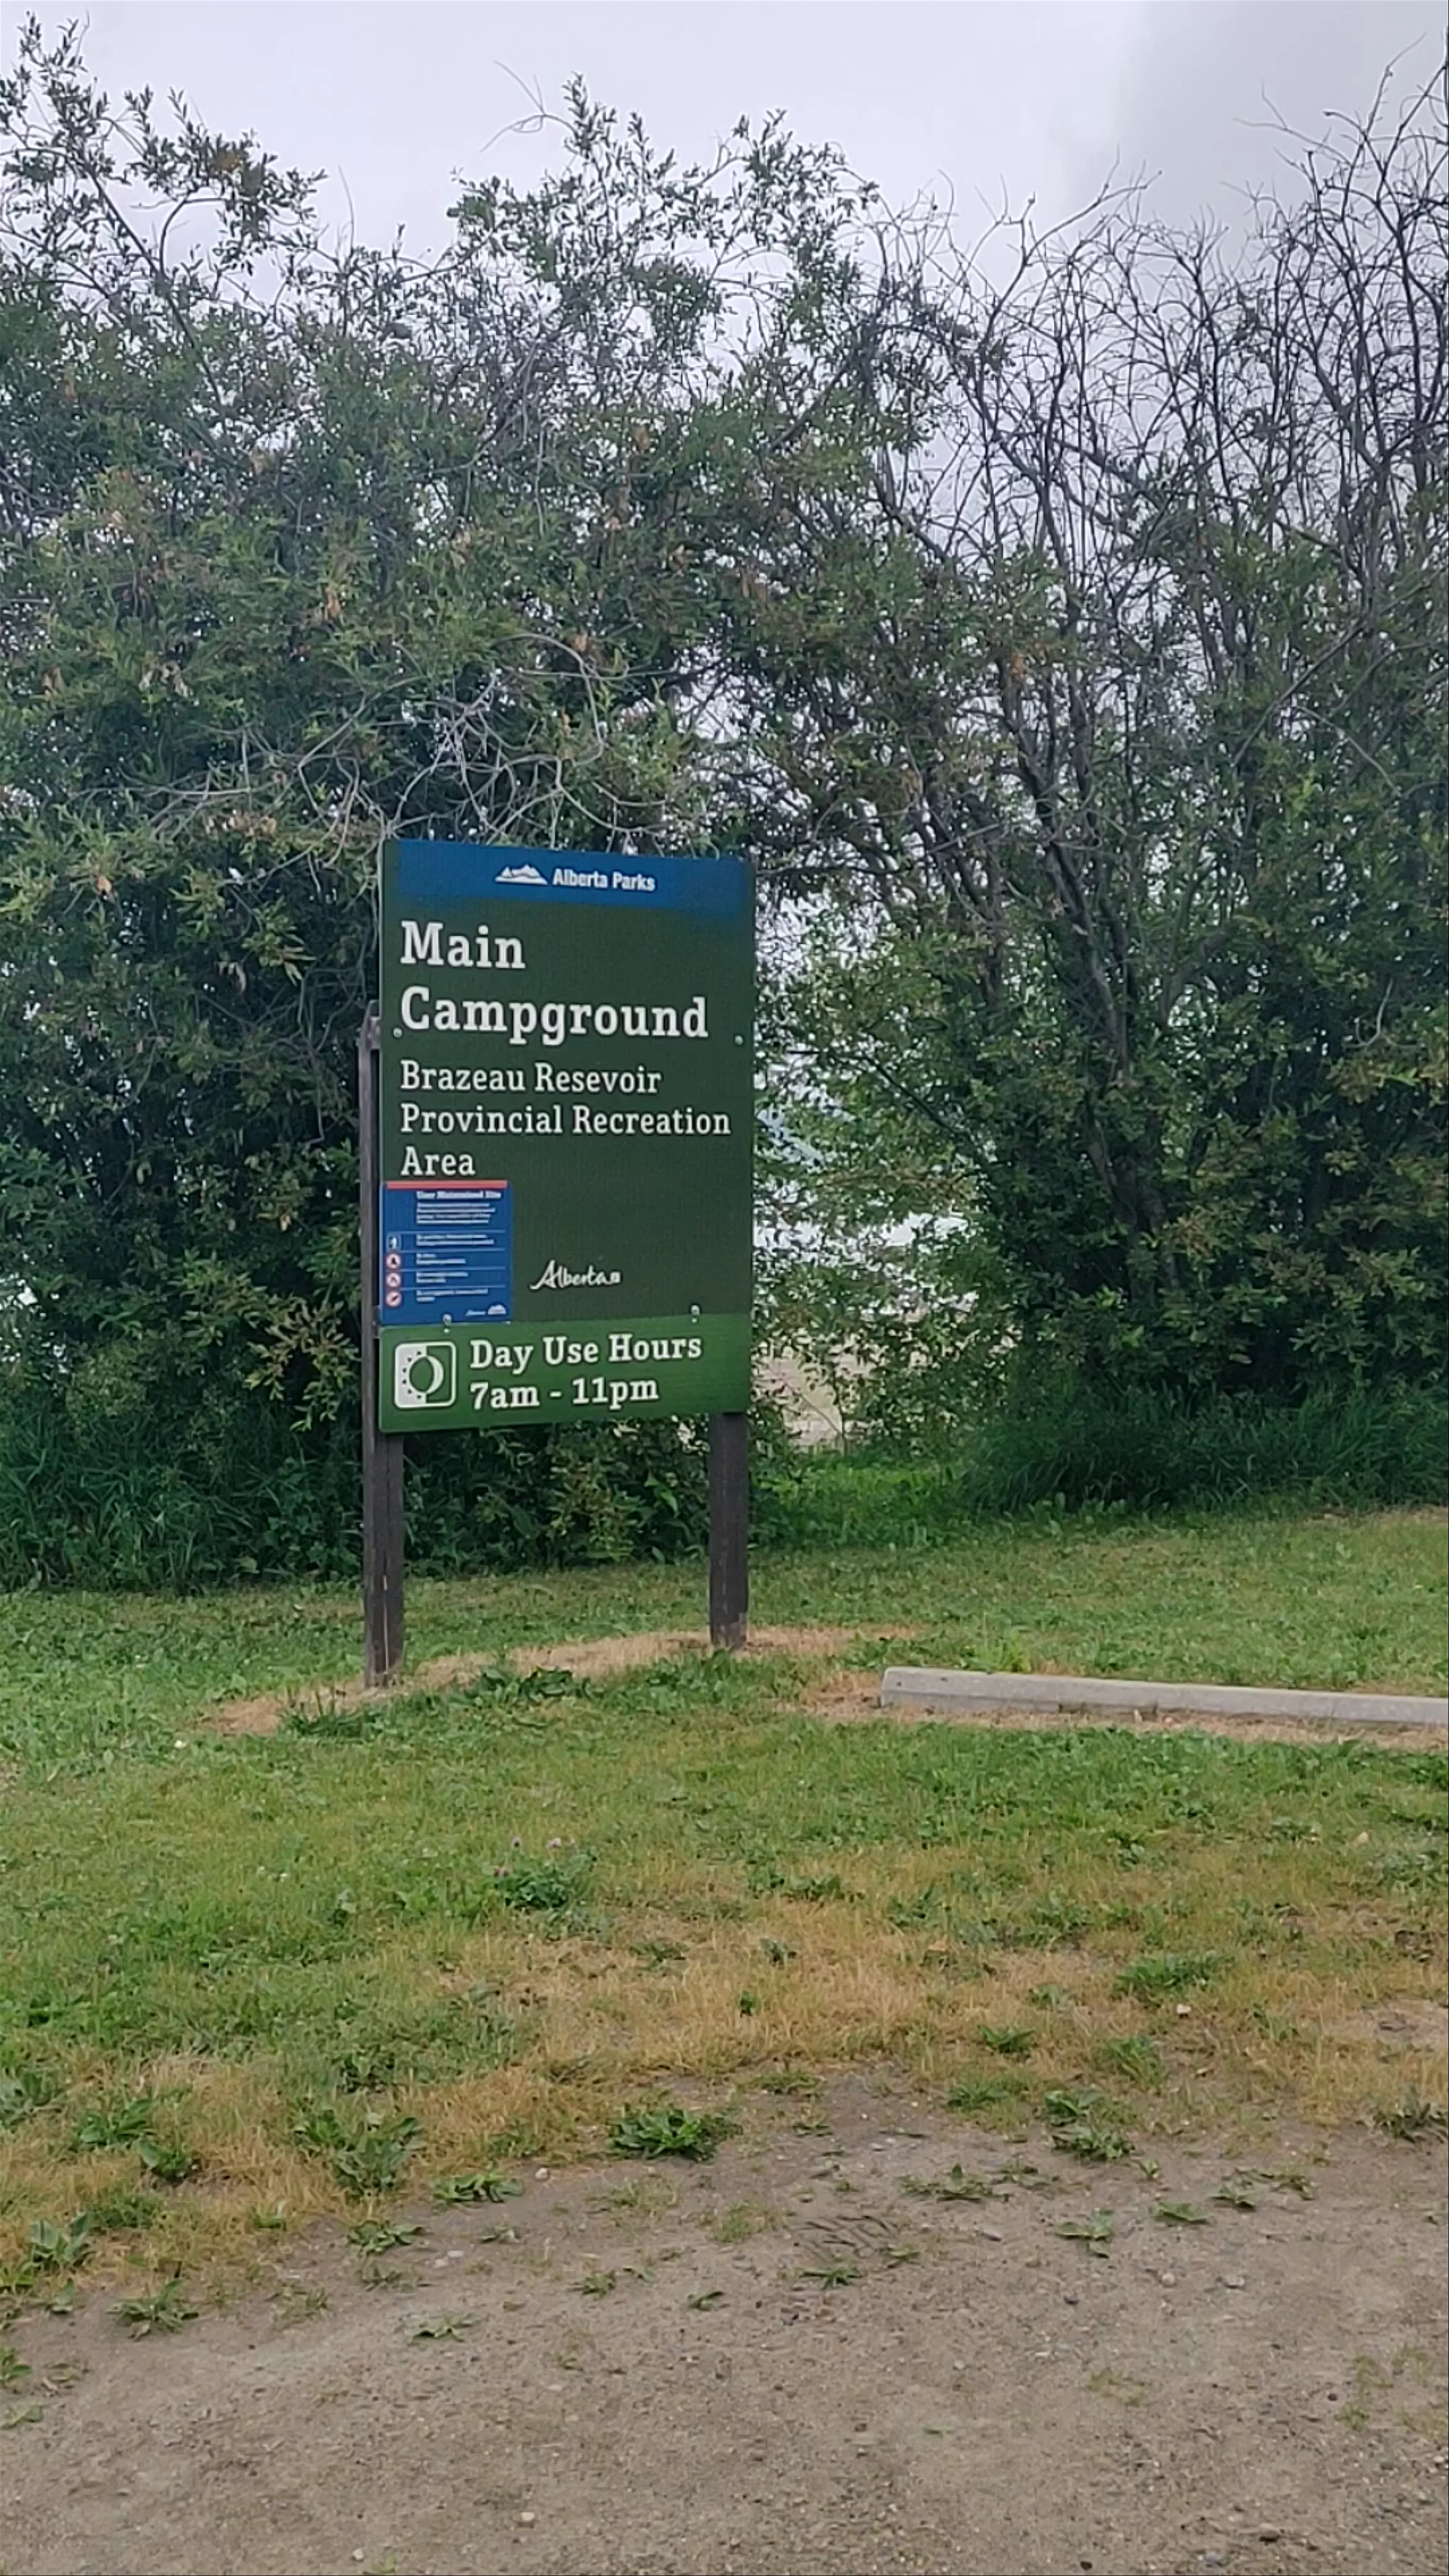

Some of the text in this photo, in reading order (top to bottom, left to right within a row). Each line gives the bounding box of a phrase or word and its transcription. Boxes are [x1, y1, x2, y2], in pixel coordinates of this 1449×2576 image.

[552, 868, 655, 891] Alberta Parks
[400, 920, 526, 969] Main
[401, 986, 709, 1046] Campground
[400, 1060, 661, 1093] Brazeau Resevoir
[401, 1103, 731, 1134] Provincial Recreation
[401, 1146, 475, 1176] Area
[529, 1260, 609, 1290] Alberta
[470, 1333, 701, 1375] Day Use Hours
[470, 1382, 540, 1410] 7am
[572, 1376, 659, 1410] 11pm
